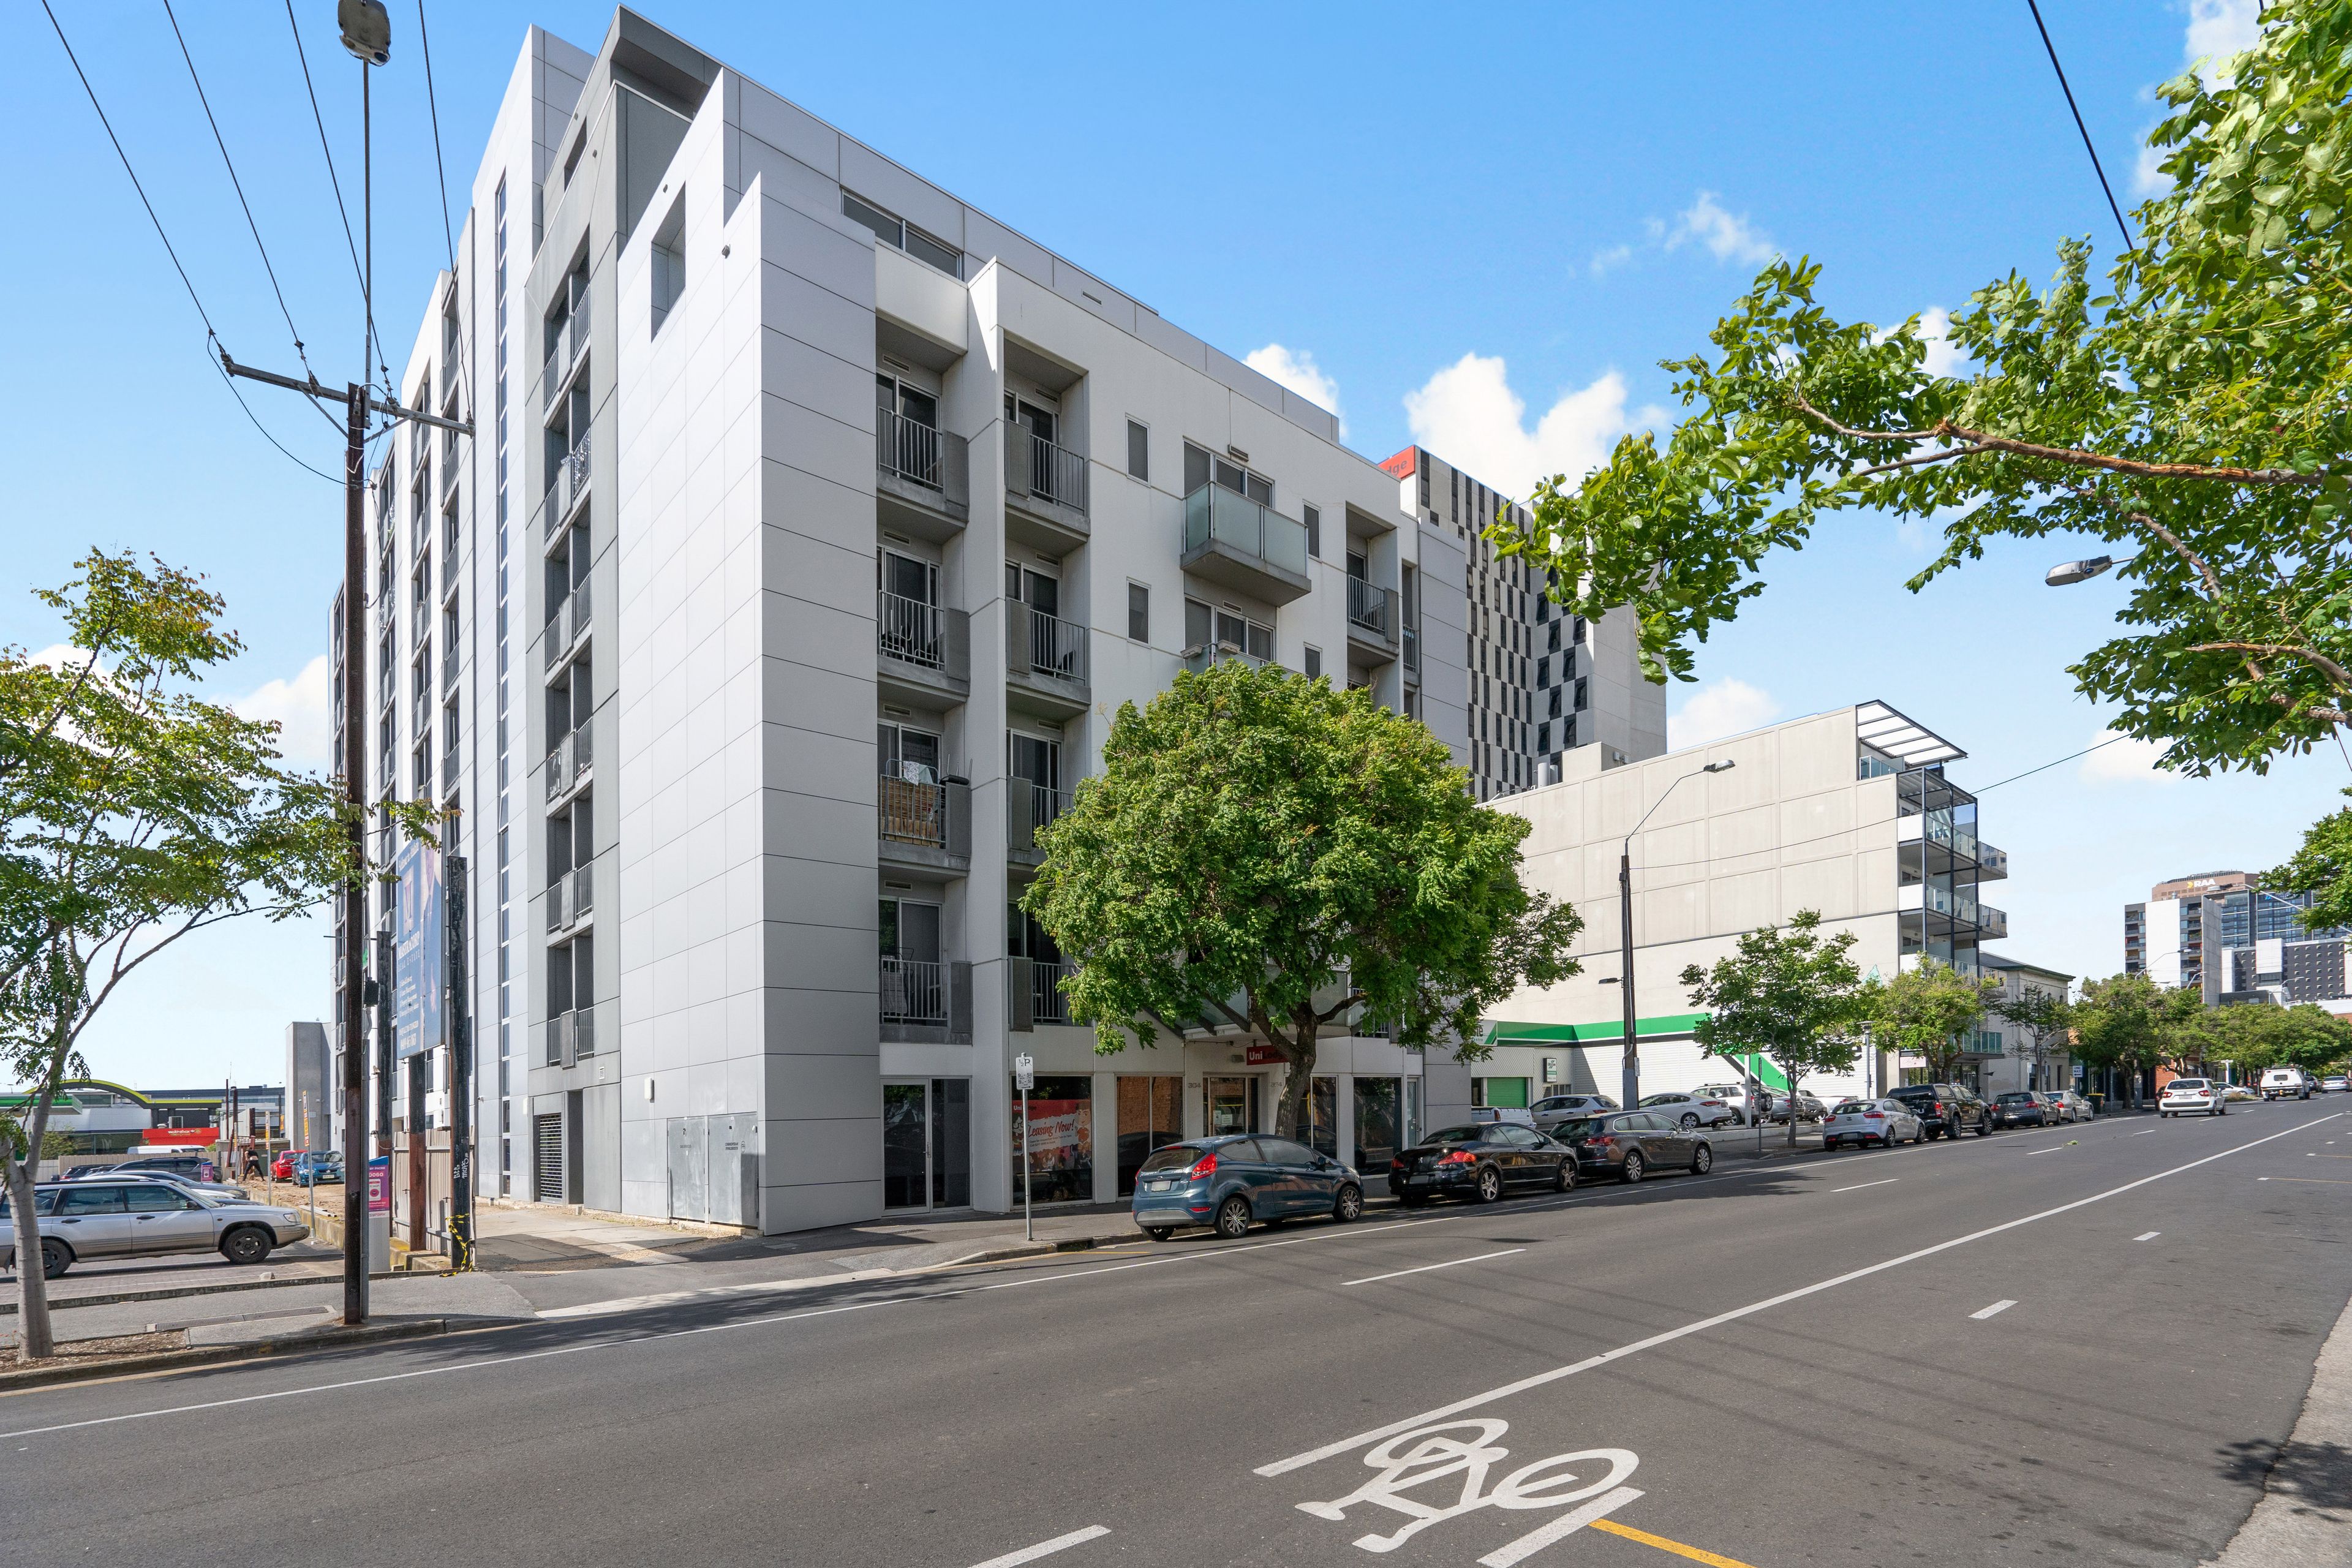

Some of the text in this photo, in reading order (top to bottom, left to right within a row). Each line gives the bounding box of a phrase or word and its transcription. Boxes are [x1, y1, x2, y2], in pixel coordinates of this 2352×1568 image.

[2194, 878, 2215, 888] RAA
[1028, 1119, 1075, 1137] Leasing Now!
